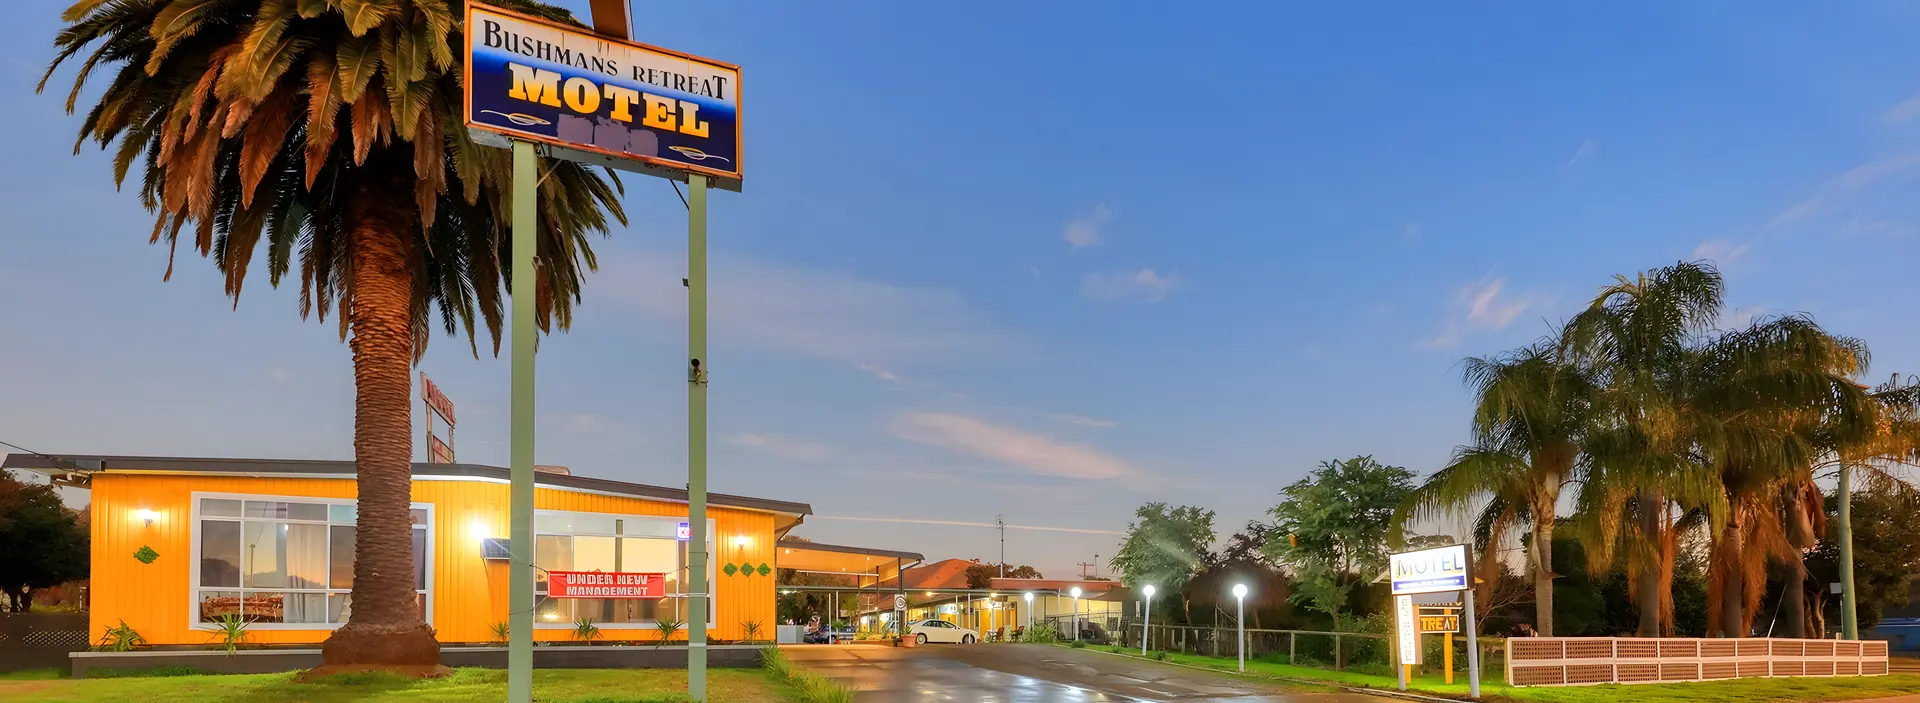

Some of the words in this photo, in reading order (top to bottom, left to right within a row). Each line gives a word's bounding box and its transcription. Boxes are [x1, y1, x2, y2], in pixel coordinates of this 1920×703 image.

[483, 19, 619, 77] BUSHMANS
[632, 65, 728, 100] RETREAT
[508, 61, 710, 139] MOTEL
[1395, 552, 1464, 579] MOTEL
[566, 573, 614, 585] UNDER
[616, 574, 649, 585] NEW
[566, 586, 649, 596] MANAGEMENT
[1420, 616, 1457, 631] TREAT
